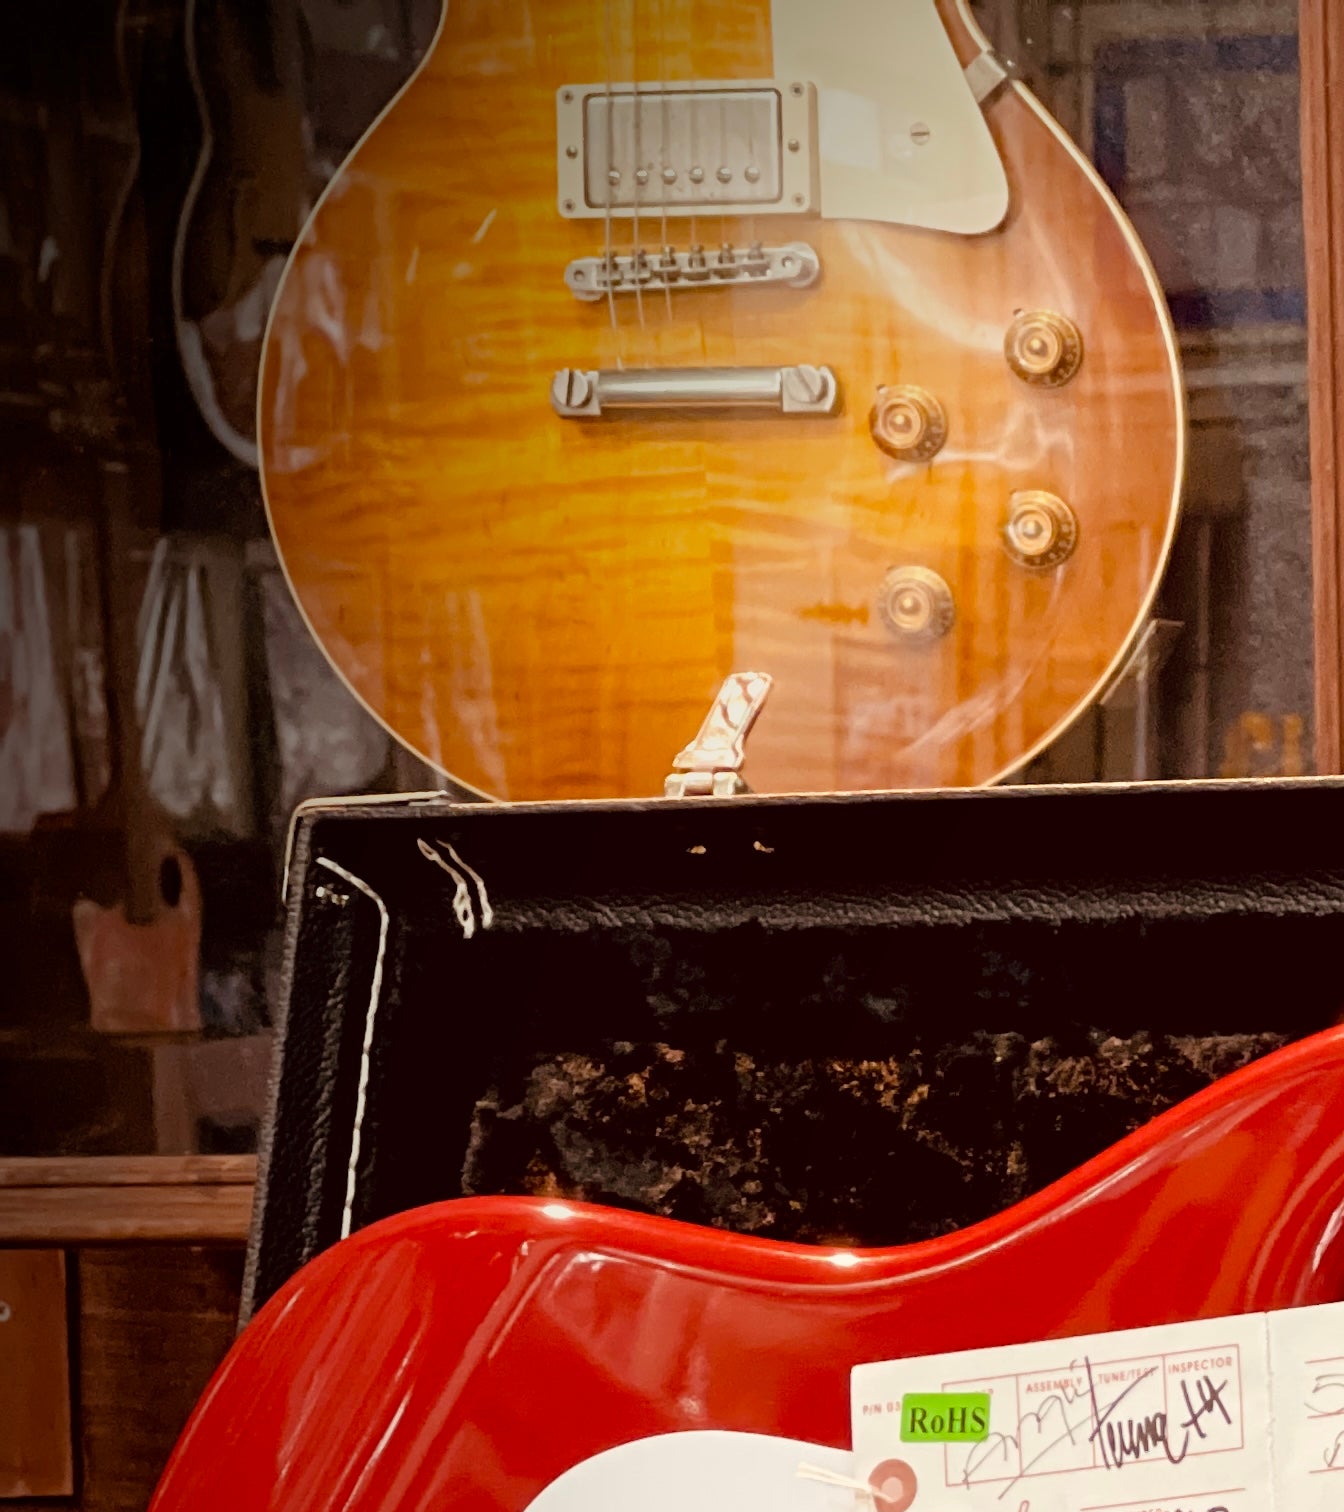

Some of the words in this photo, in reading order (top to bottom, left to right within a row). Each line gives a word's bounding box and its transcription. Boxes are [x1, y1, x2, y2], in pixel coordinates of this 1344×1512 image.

[1168, 1356, 1233, 1374] INSPECTOR
[1026, 1377, 1083, 1393] ASSEMBLY
[909, 1406, 986, 1434] RoHS
